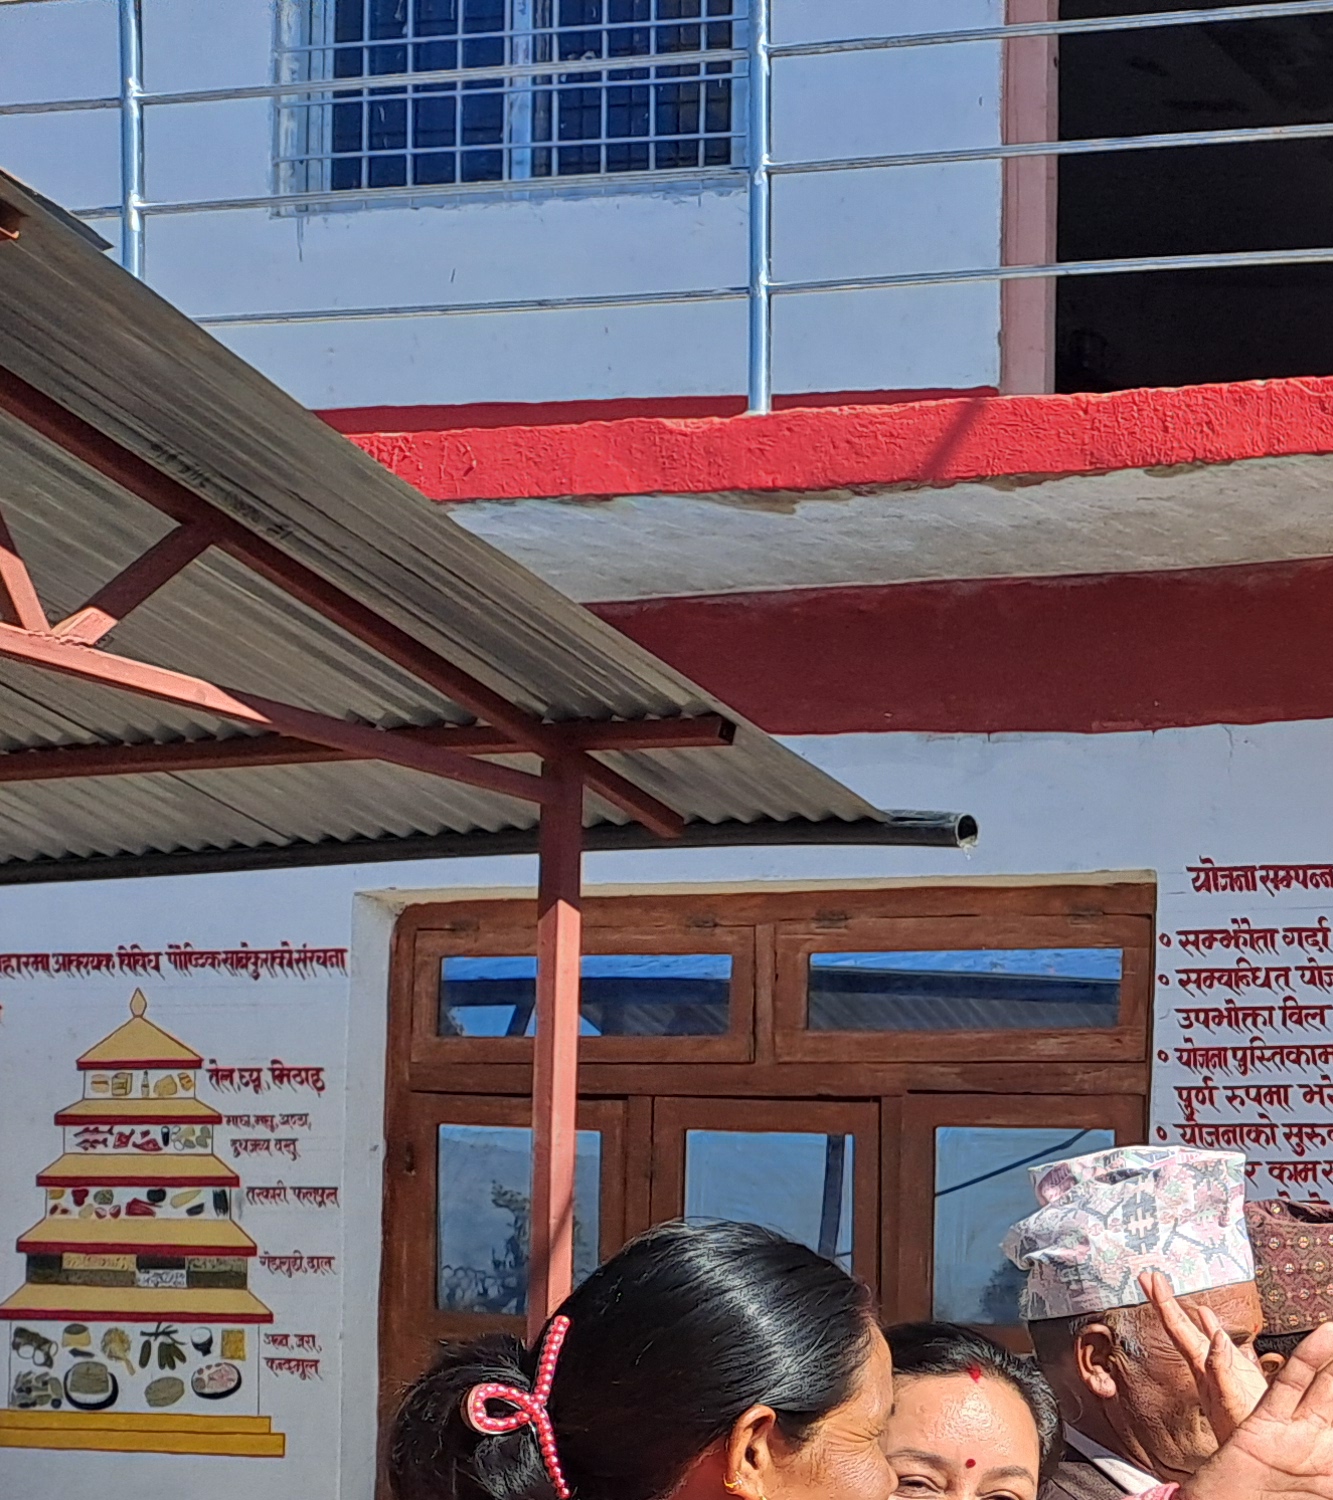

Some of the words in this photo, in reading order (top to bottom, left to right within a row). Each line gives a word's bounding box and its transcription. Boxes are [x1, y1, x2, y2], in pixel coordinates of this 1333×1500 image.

[1186, 854, 1258, 894] योजना
[1282, 916, 1333, 954] गर्दा
[1174, 1036, 1234, 1077] योजना
[1173, 1113, 1288, 1150] योजनाको
[1265, 1160, 1326, 1189] काम
